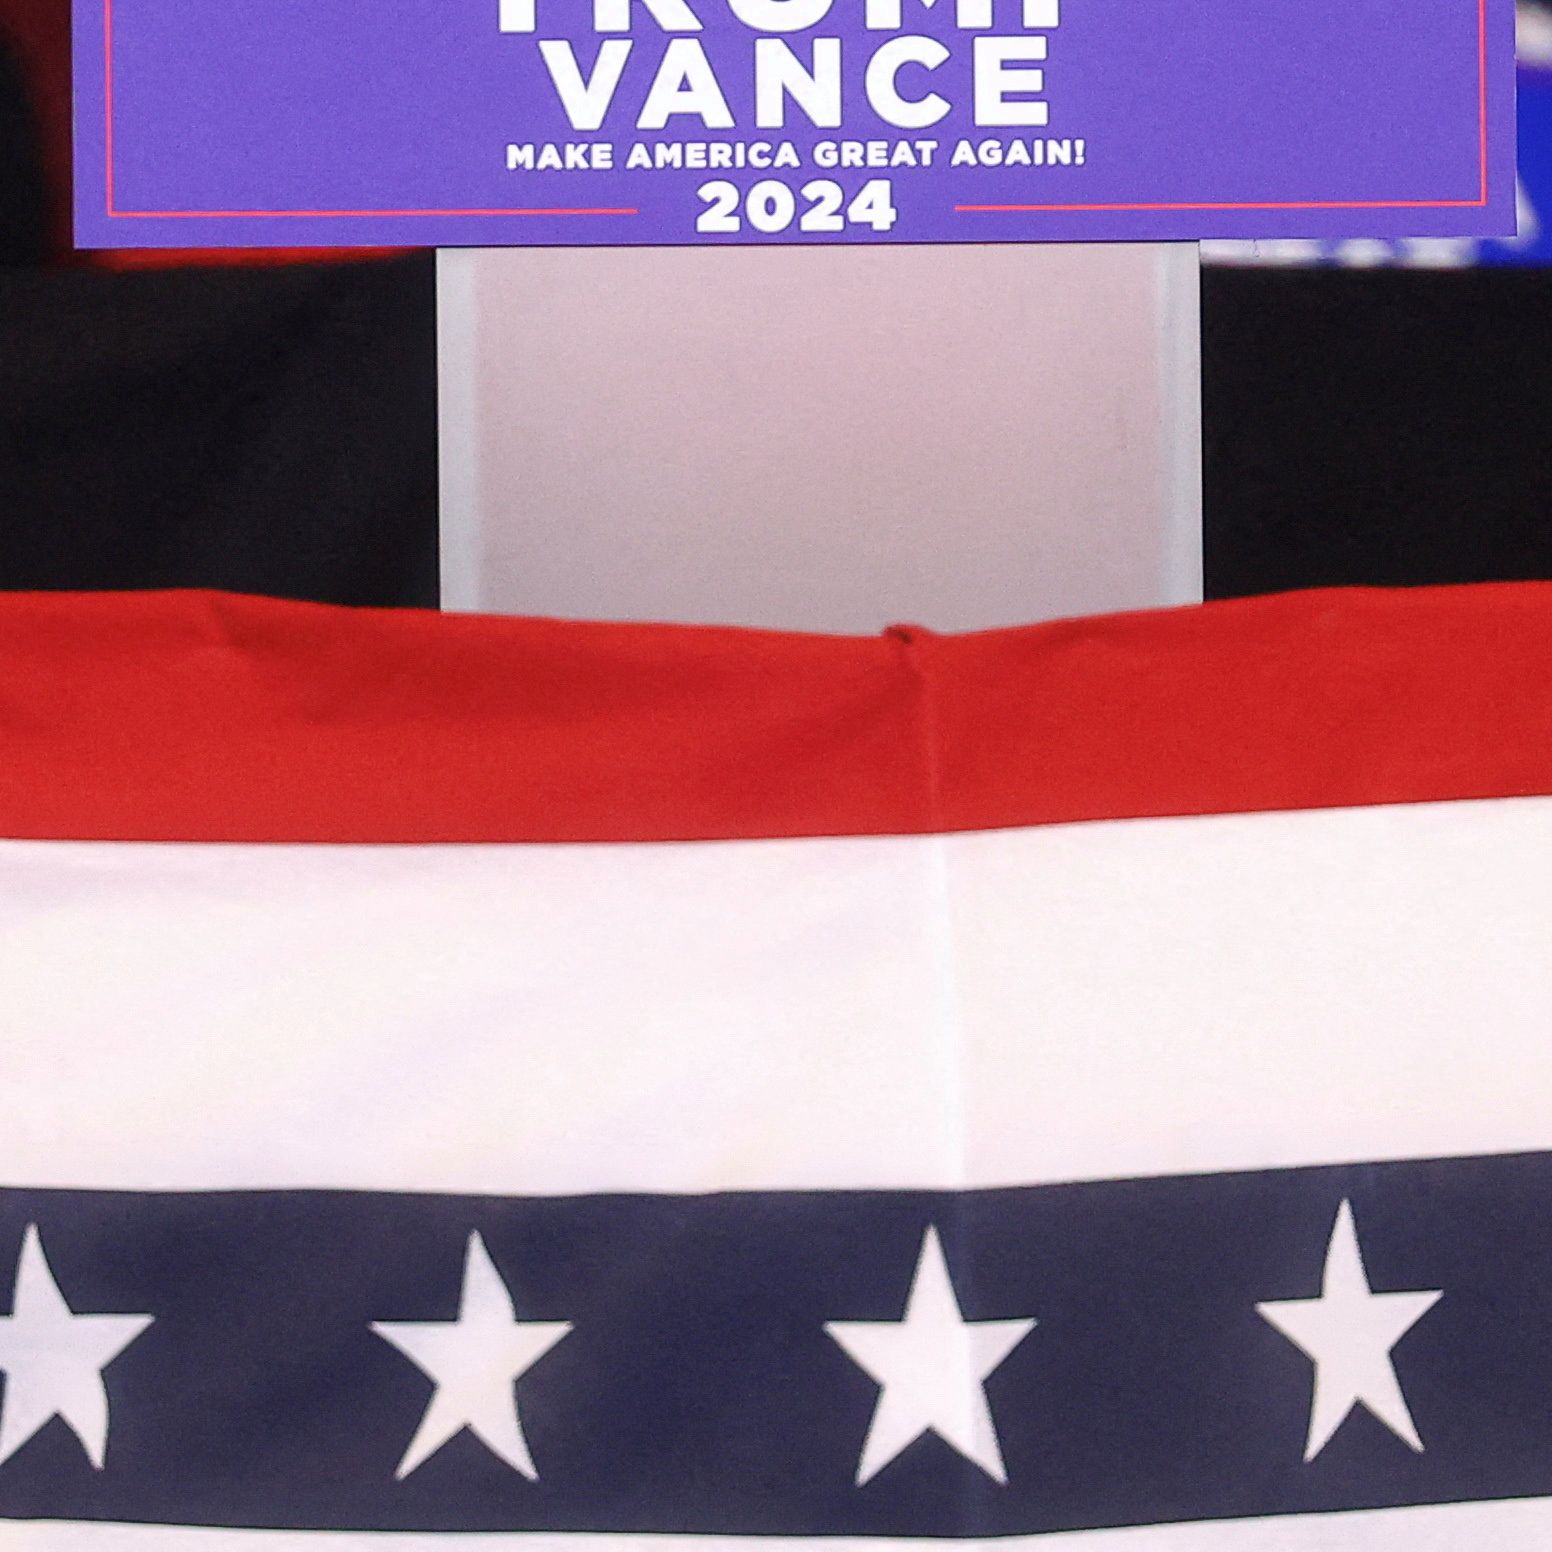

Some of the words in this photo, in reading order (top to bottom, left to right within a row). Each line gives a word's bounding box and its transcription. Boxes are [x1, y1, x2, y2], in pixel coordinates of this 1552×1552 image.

[537, 35, 1049, 131] VANCE
[506, 142, 614, 170] MAKE
[626, 141, 802, 169] AMERICA
[812, 139, 939, 168] GREAT
[951, 138, 1086, 166] AGAIN!
[696, 179, 897, 233] 2024
